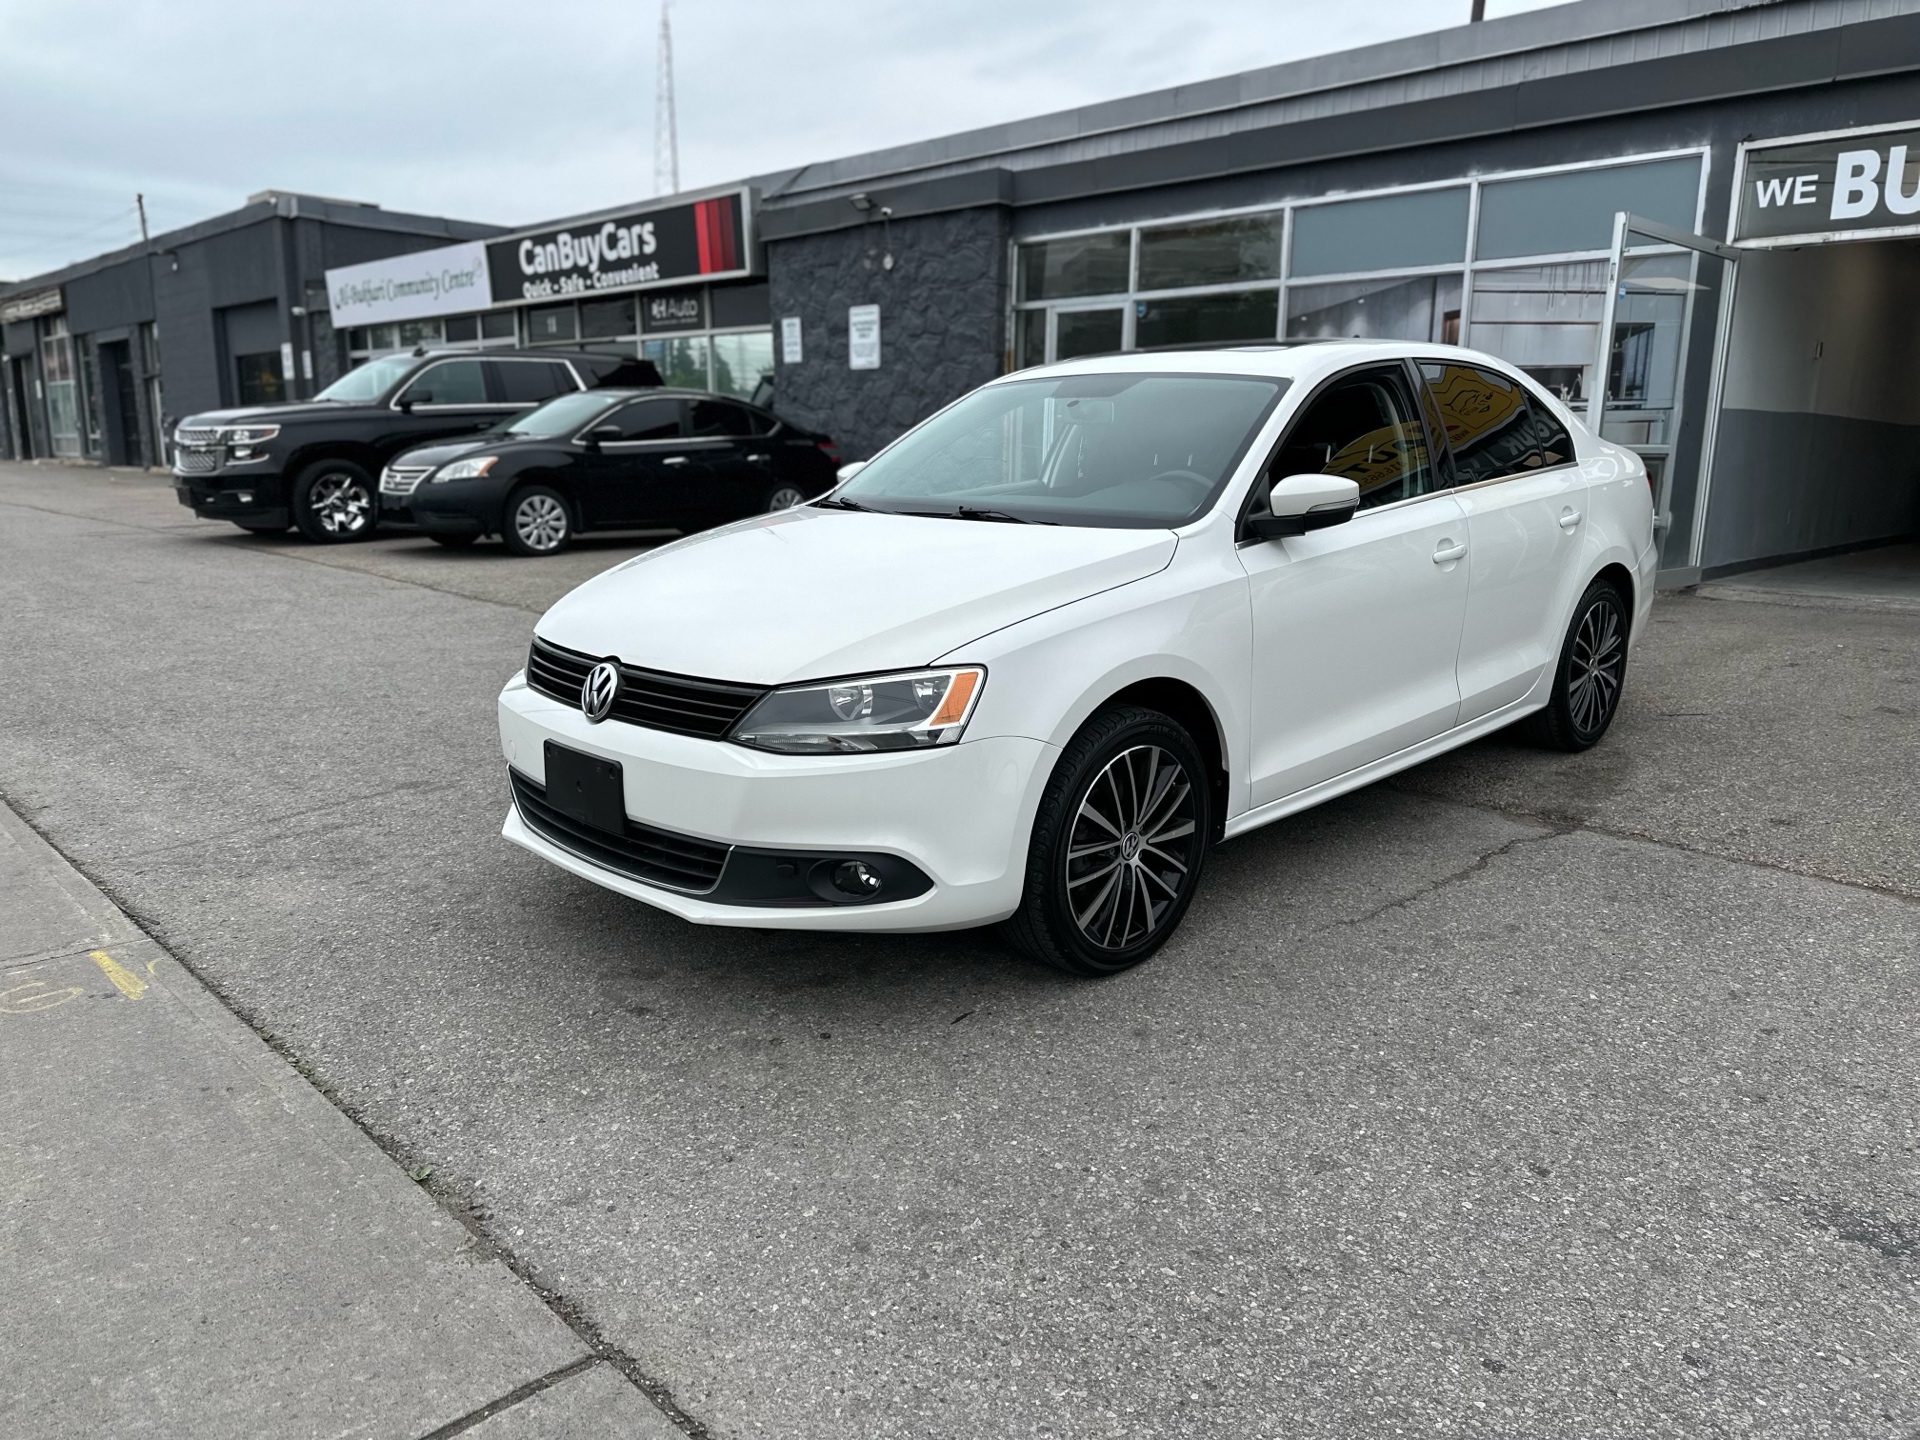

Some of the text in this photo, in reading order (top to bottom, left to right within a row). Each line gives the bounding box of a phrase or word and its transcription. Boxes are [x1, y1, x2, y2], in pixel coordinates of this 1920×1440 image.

[1755, 174, 1819, 208] WE
[518, 221, 657, 275] CanBuyCars
[386, 272, 440, 301] Community
[441, 268, 475, 294] Centre
[523, 261, 659, 299] Quick Safe Convenient
